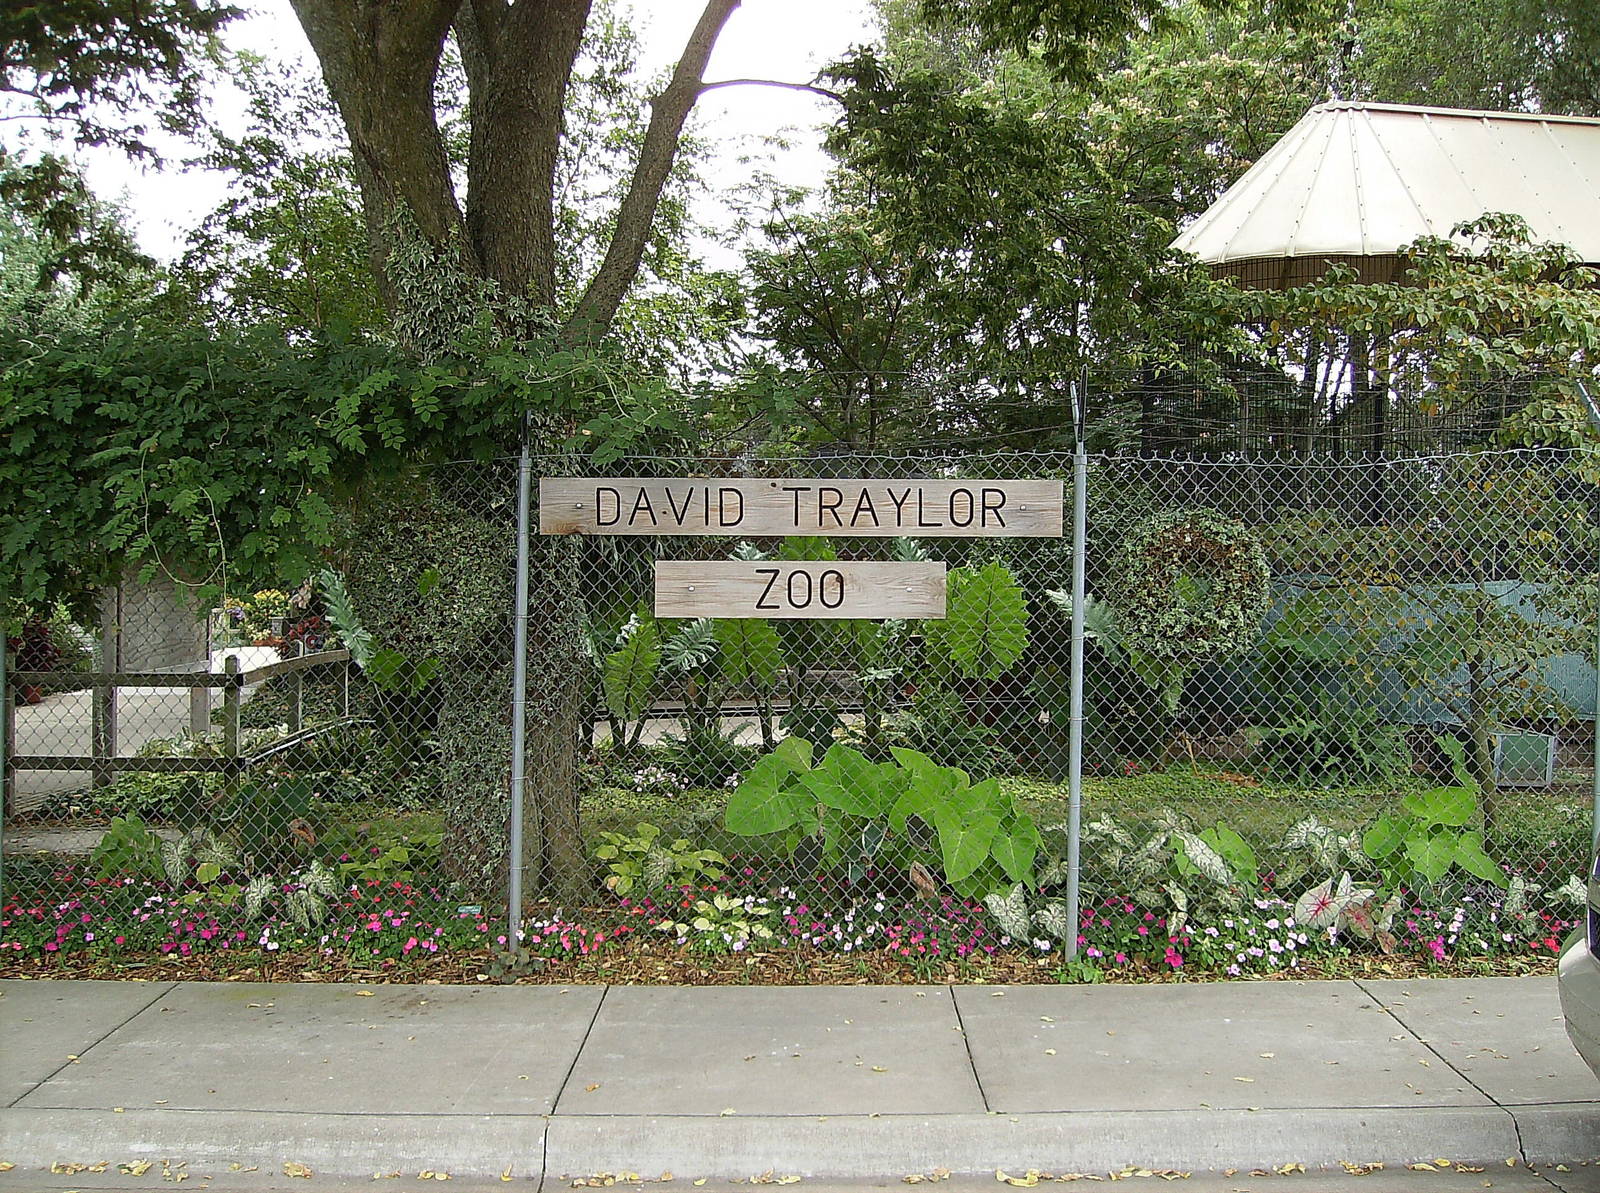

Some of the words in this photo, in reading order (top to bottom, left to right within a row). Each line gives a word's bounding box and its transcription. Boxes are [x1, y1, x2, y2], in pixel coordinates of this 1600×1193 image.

[595, 486, 745, 527] DAVID
[782, 486, 1007, 528] TRAYLOR
[755, 568, 845, 610] ZOO
